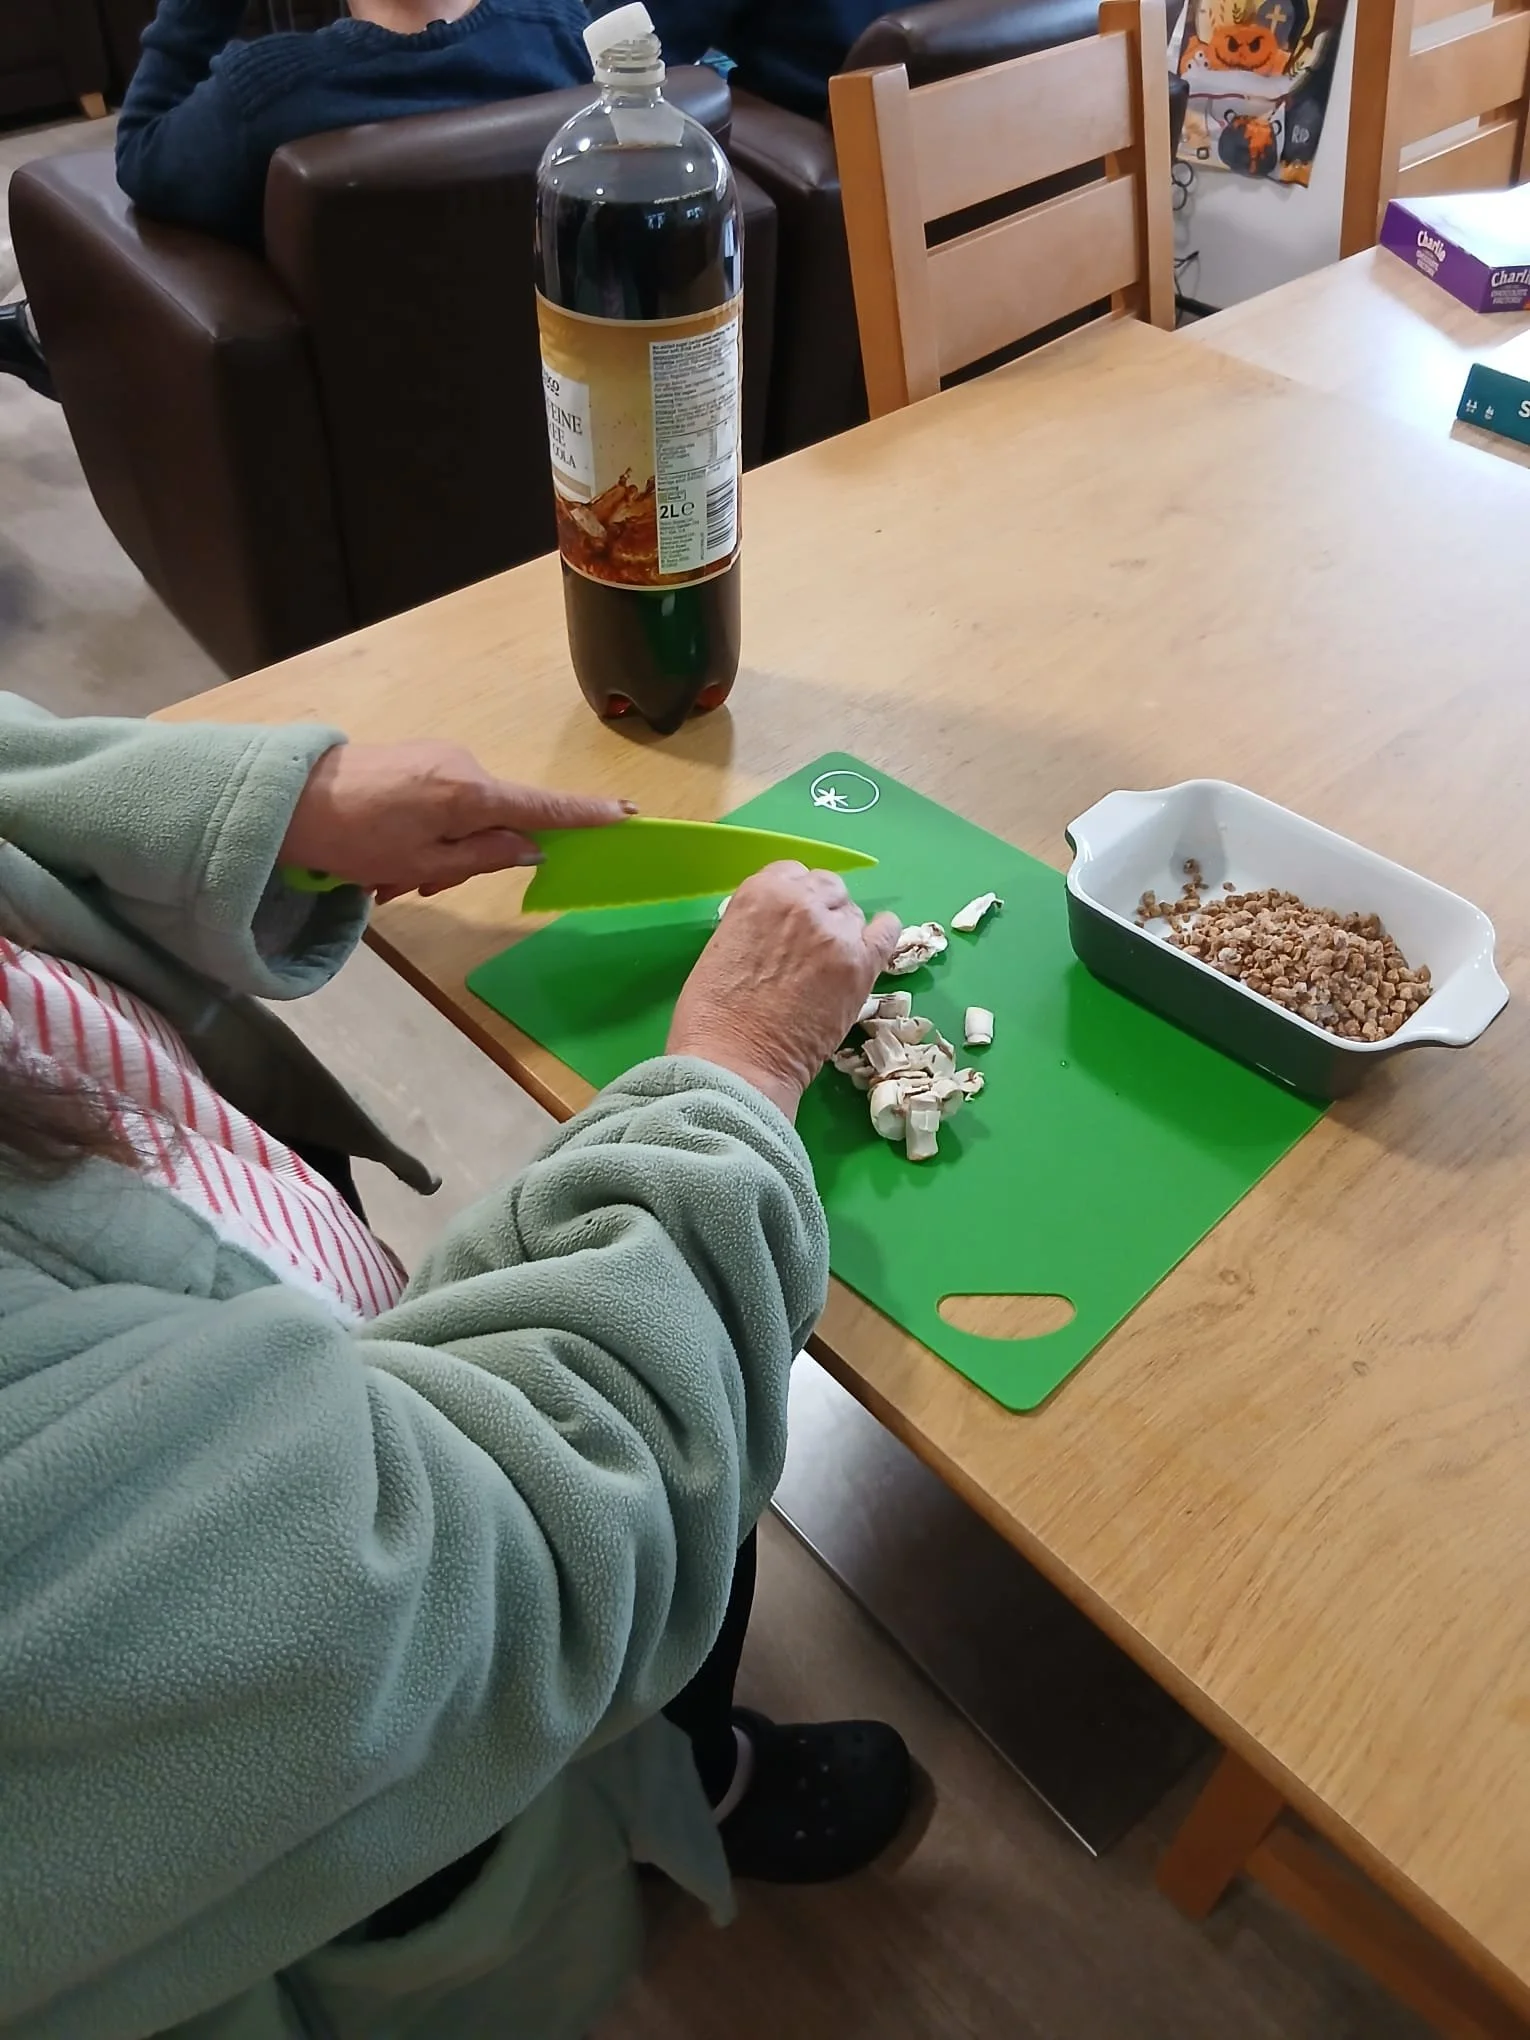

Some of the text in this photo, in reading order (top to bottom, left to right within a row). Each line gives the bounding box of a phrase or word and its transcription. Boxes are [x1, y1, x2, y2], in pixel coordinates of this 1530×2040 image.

[1417, 230, 1446, 262] Charlie
[1490, 269, 1530, 288] Charli
[547, 400, 582, 436] FEINE
